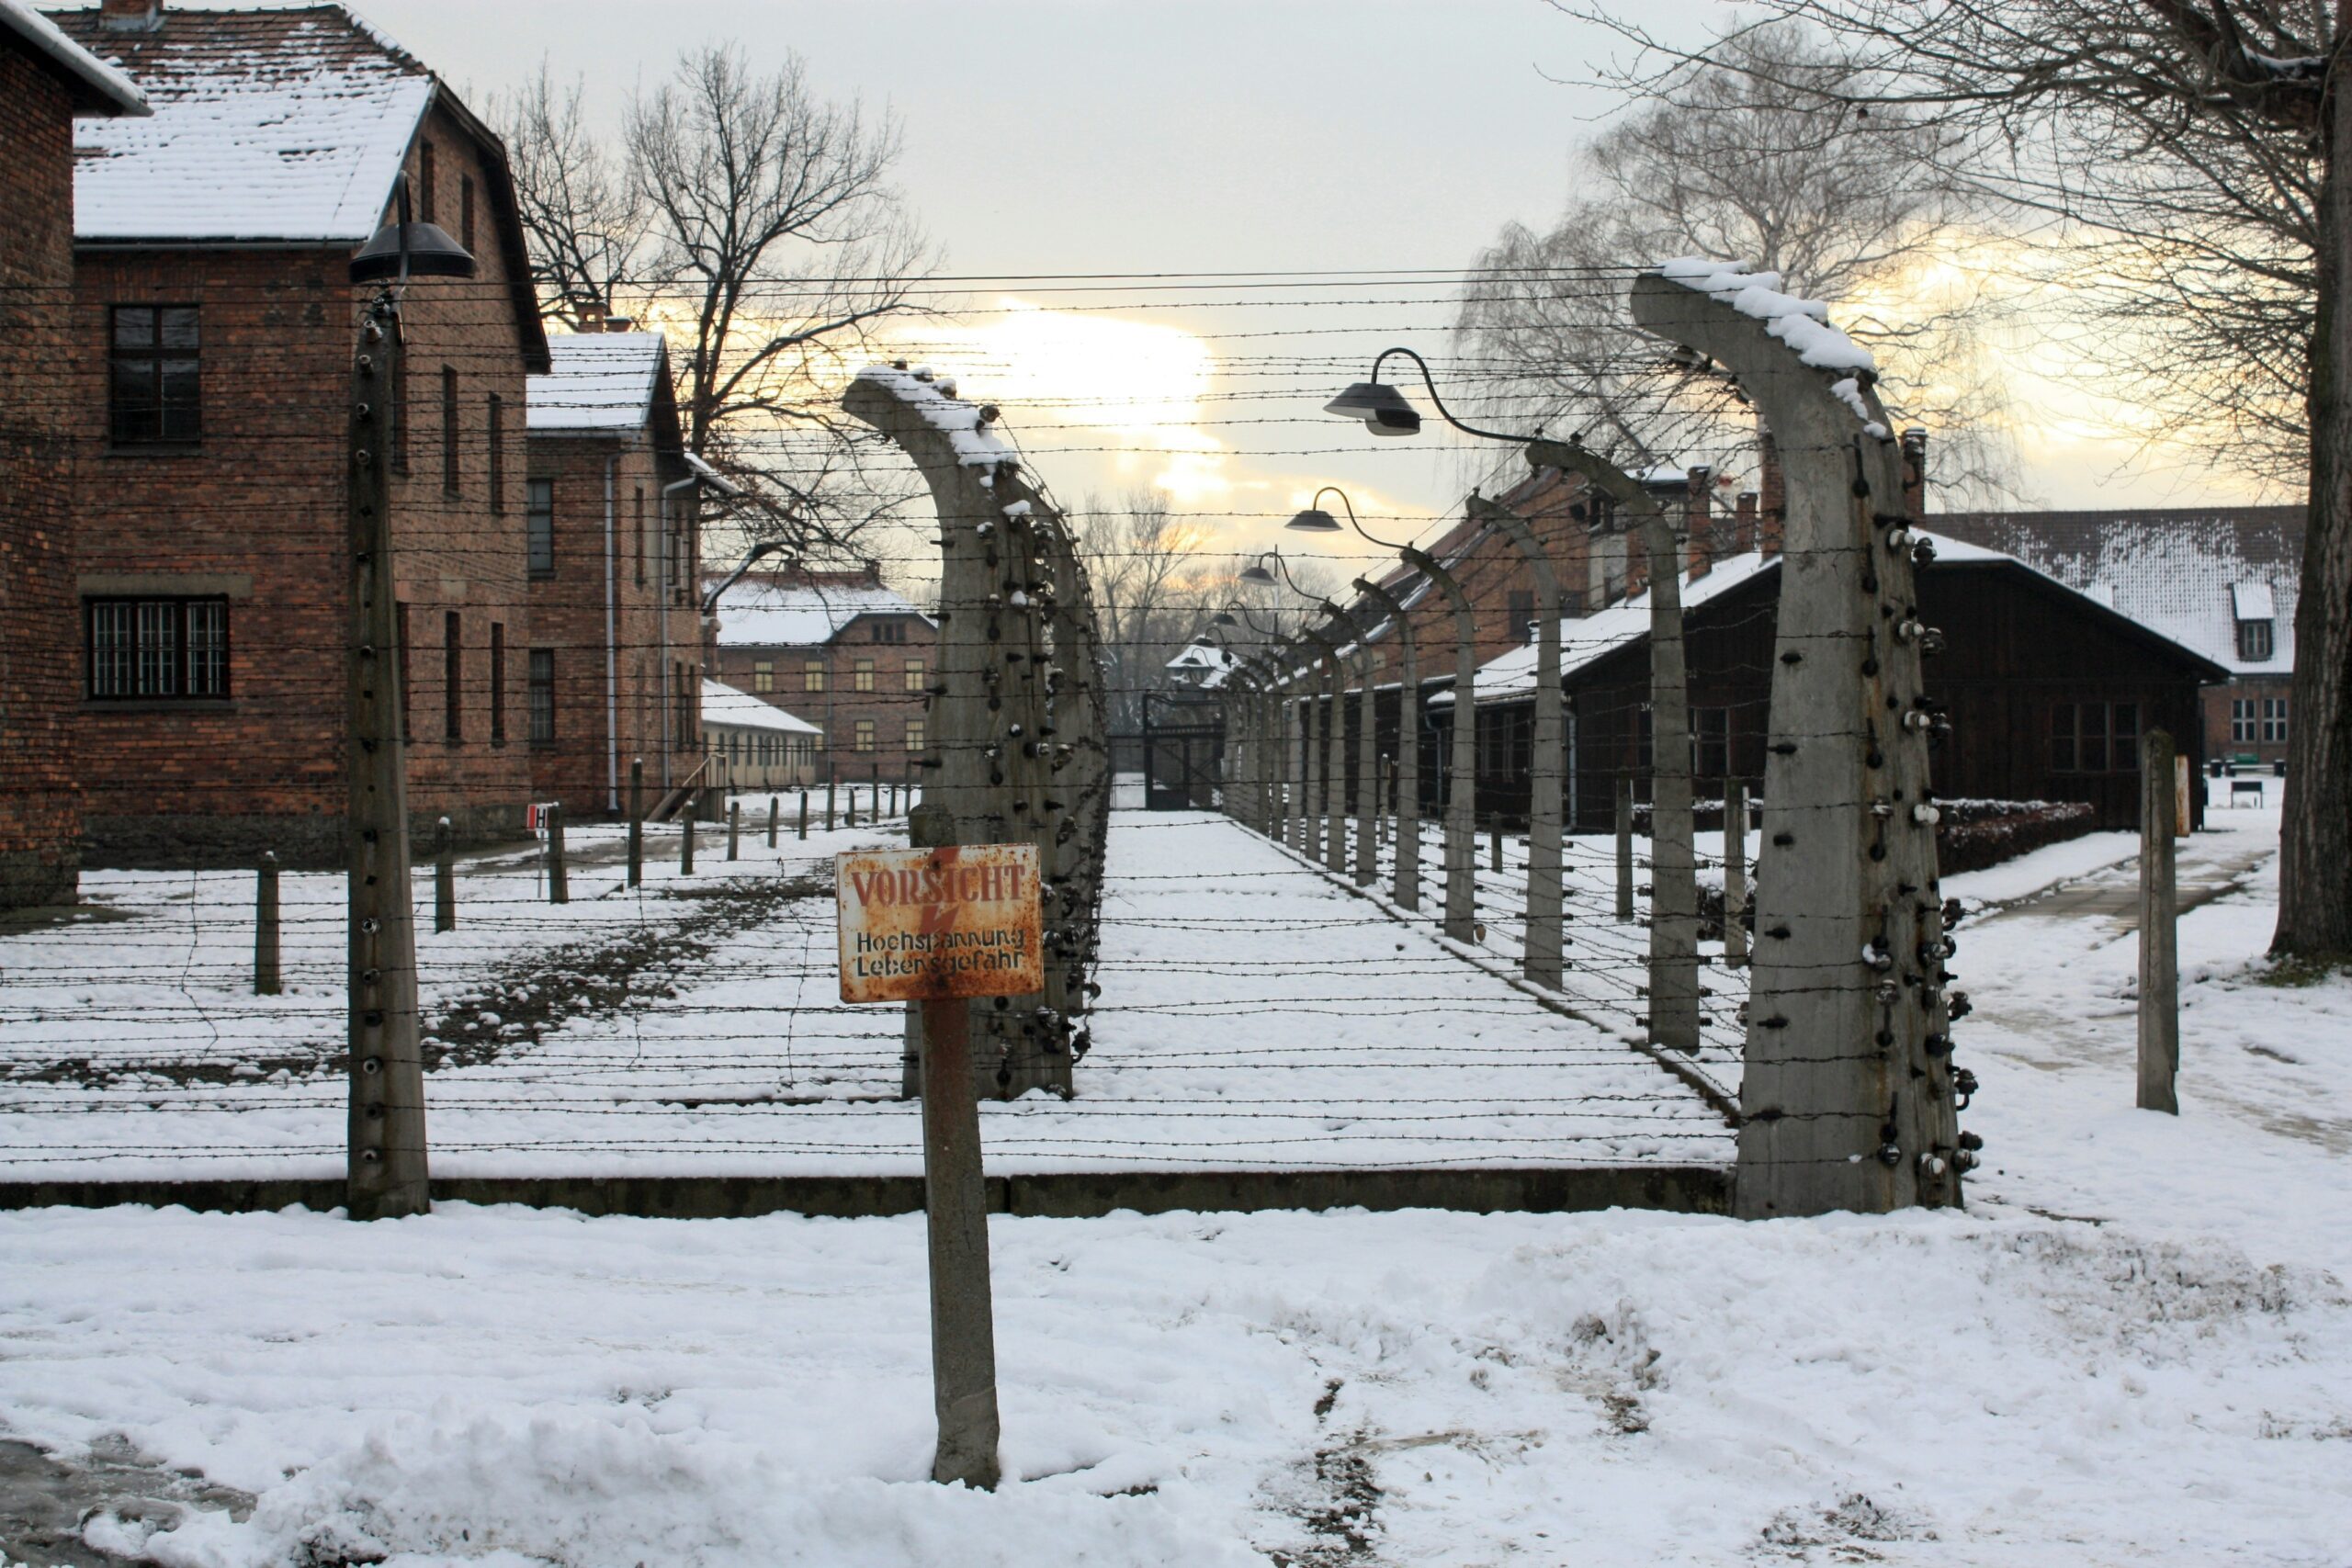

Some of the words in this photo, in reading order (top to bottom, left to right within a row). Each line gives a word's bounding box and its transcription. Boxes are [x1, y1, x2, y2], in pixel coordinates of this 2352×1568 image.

[537, 807, 546, 829] H
[851, 863, 1026, 908] VORSICHT
[857, 929, 1025, 953] Hochspannung
[857, 949, 1025, 977] Lebensgefahr
